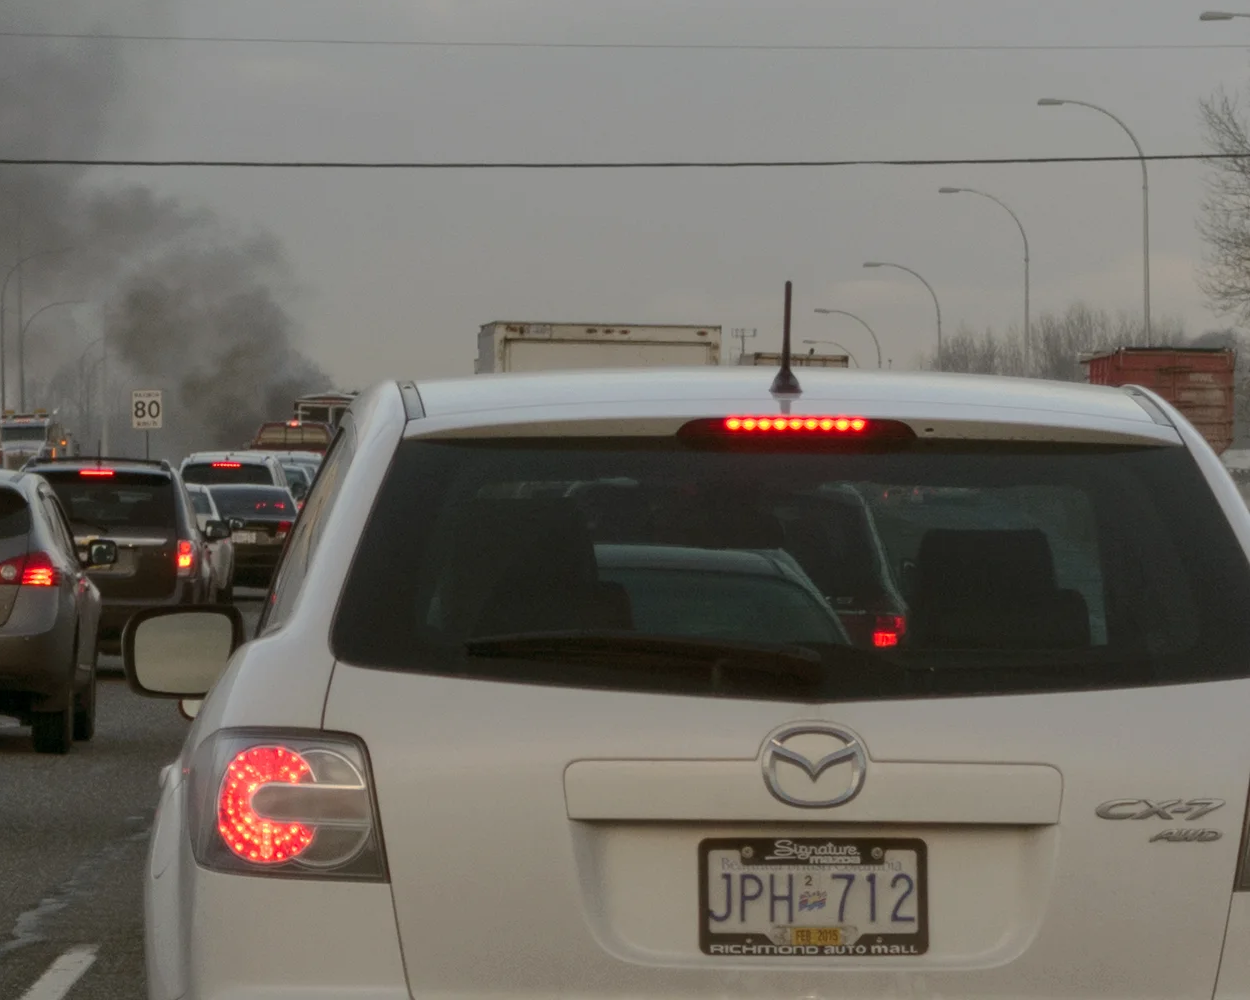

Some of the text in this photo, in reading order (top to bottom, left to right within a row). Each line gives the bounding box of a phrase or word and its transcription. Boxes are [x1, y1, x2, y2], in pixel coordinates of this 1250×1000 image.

[134, 400, 160, 418] 80
[1095, 798, 1226, 821] CX-7
[1148, 828, 1223, 842] AWD
[809, 855, 861, 865] mazda
[804, 875, 813, 887] 2
[708, 874, 916, 923] JPH 712
[795, 930, 812, 942] FEB
